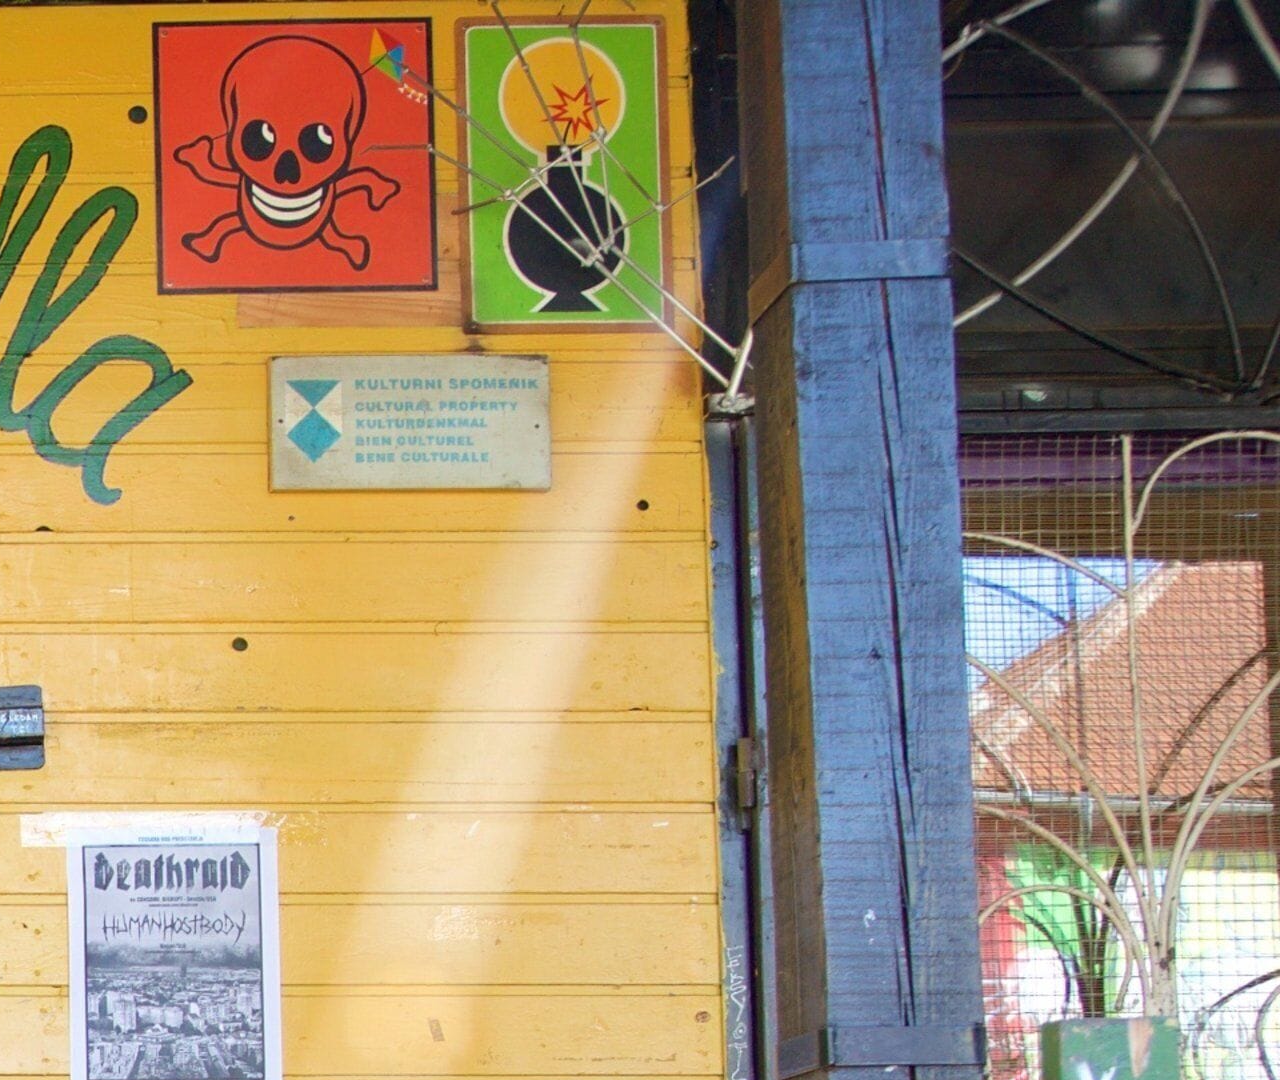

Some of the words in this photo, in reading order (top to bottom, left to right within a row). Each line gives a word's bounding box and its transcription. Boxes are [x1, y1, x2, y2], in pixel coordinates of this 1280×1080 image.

[355, 379, 442, 390] KULTURNI
[449, 378, 539, 389] SPOMENIK
[355, 401, 433, 412] CULTURAL
[439, 401, 518, 411] PROPERTY
[355, 418, 487, 429] KULTURDENKMAL
[355, 436, 392, 446] BIEN
[397, 436, 474, 446] CULTUREL
[355, 453, 395, 463] BENE
[401, 452, 489, 463] CULTURALE
